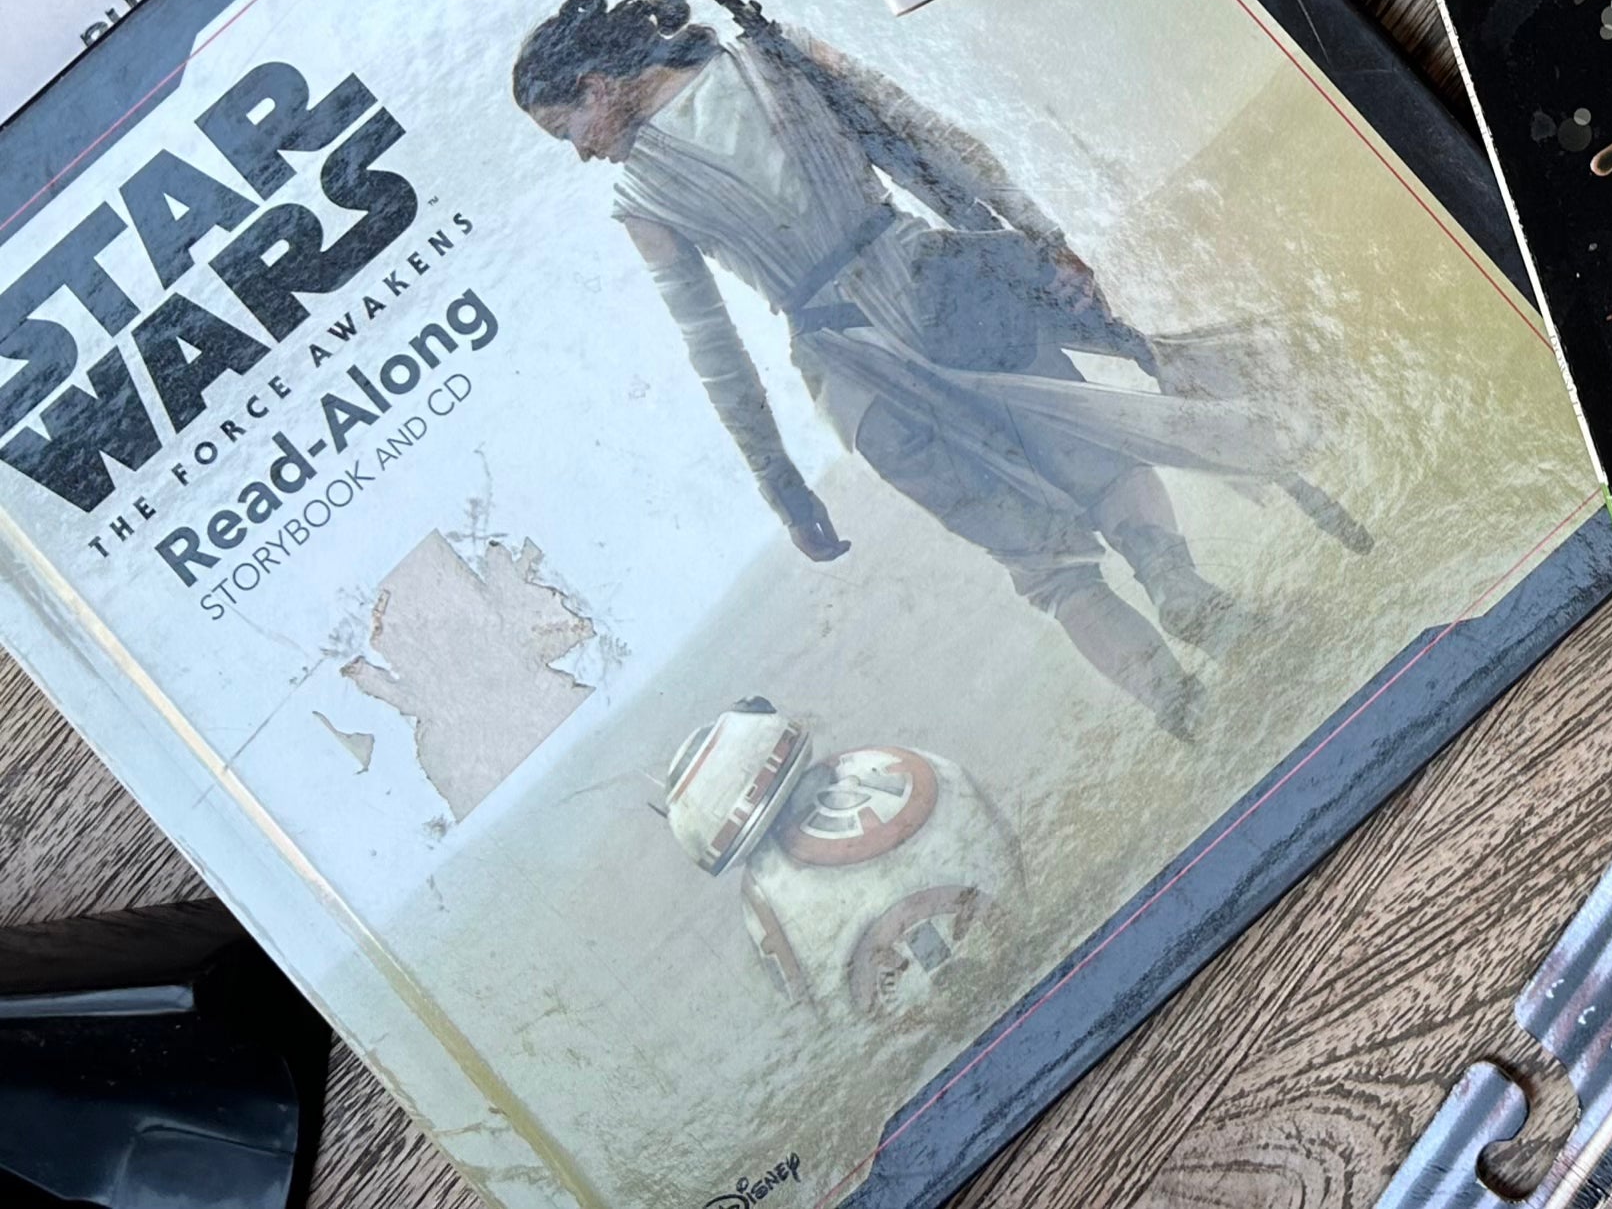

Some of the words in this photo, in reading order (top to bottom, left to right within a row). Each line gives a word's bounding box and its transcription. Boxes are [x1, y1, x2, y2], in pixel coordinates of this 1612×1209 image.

[0, 62, 378, 436] STAR
[0, 107, 418, 514] WARS
[88, 497, 156, 559] THE
[171, 375, 292, 486] FORCE
[308, 211, 474, 368] AWAKENS
[154, 287, 500, 588] Read-Along
[200, 459, 376, 622] STORYBOOK
[376, 413, 428, 472] AND
[426, 373, 473, 418] CD
